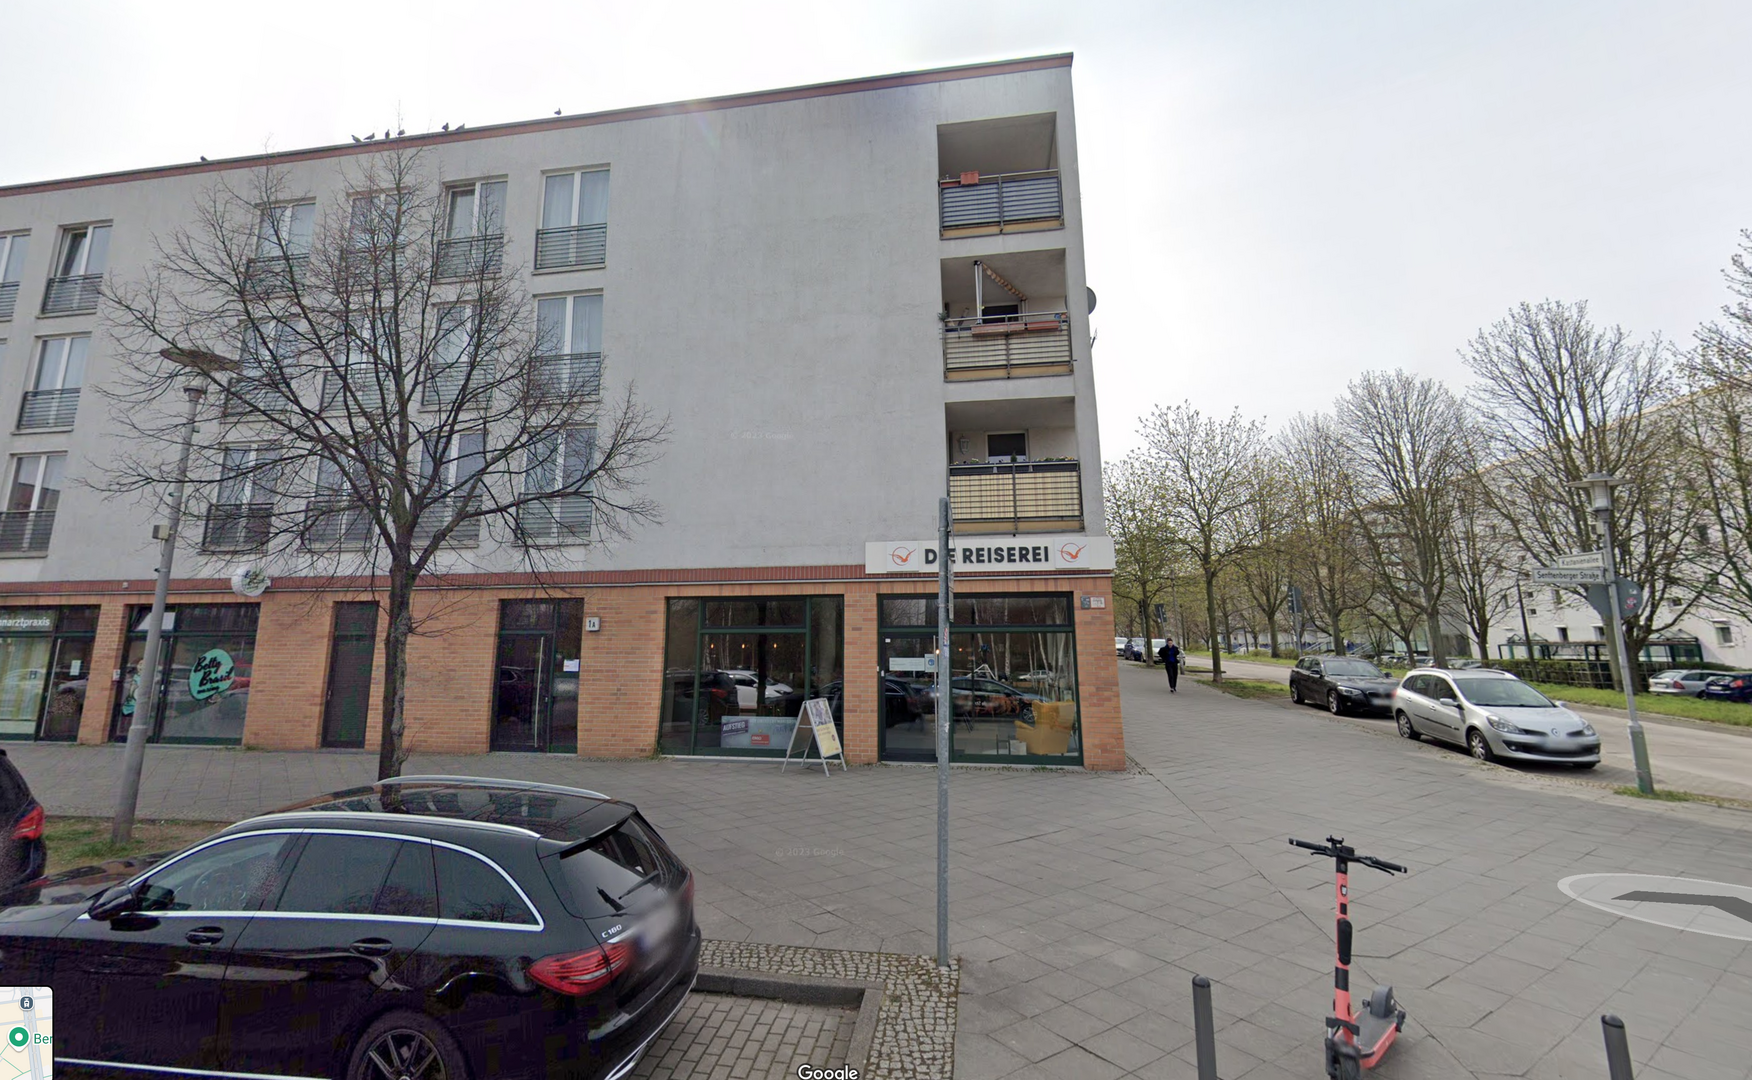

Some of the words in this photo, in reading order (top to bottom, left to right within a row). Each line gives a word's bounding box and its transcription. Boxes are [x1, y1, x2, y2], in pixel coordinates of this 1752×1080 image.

[924, 548, 956, 565] DE
[962, 546, 1049, 564] REISEREI
[1537, 570, 1579, 581] Senftenberger
[1580, 571, 1600, 581] Straße
[0, 617, 51, 628] narztpraxis
[194, 656, 221, 674] Betty
